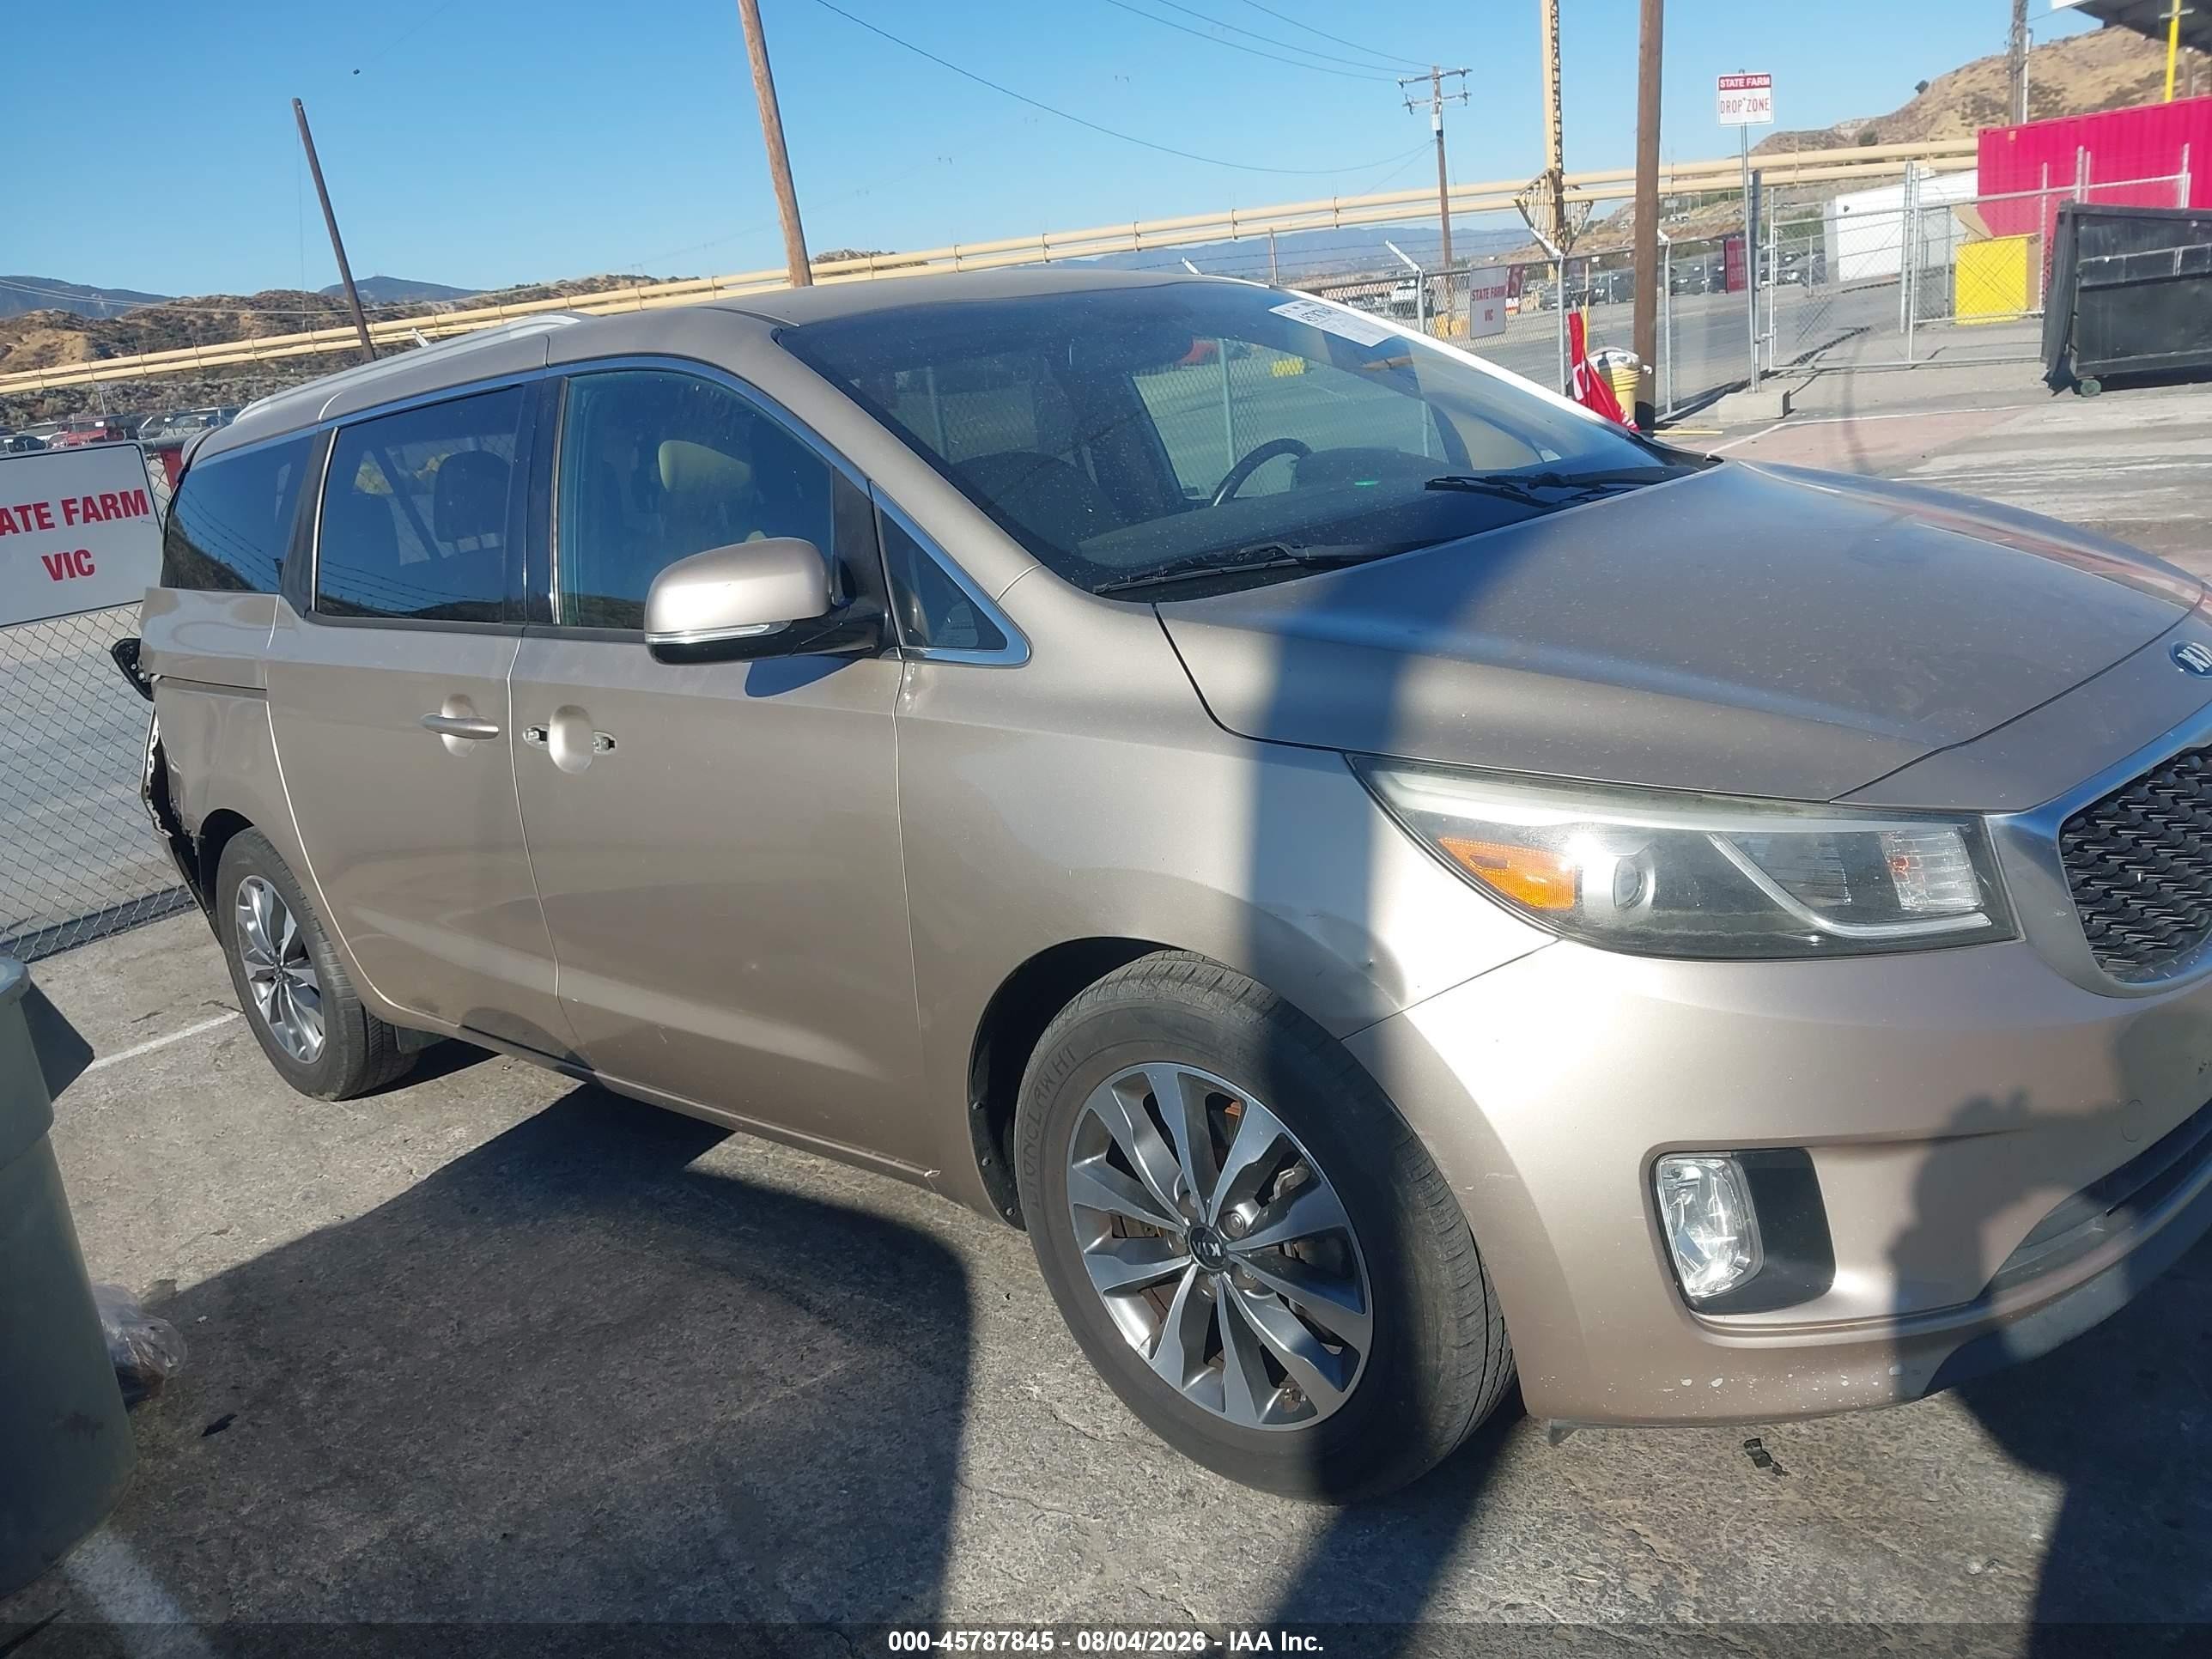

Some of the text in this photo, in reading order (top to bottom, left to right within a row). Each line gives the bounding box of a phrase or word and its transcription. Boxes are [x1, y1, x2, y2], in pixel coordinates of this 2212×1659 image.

[1720, 76, 1770, 88] STATE FARM
[1720, 97, 1770, 114] DROP ZONE
[0, 489, 149, 536] ATE FARM
[41, 549, 95, 581] VIC
